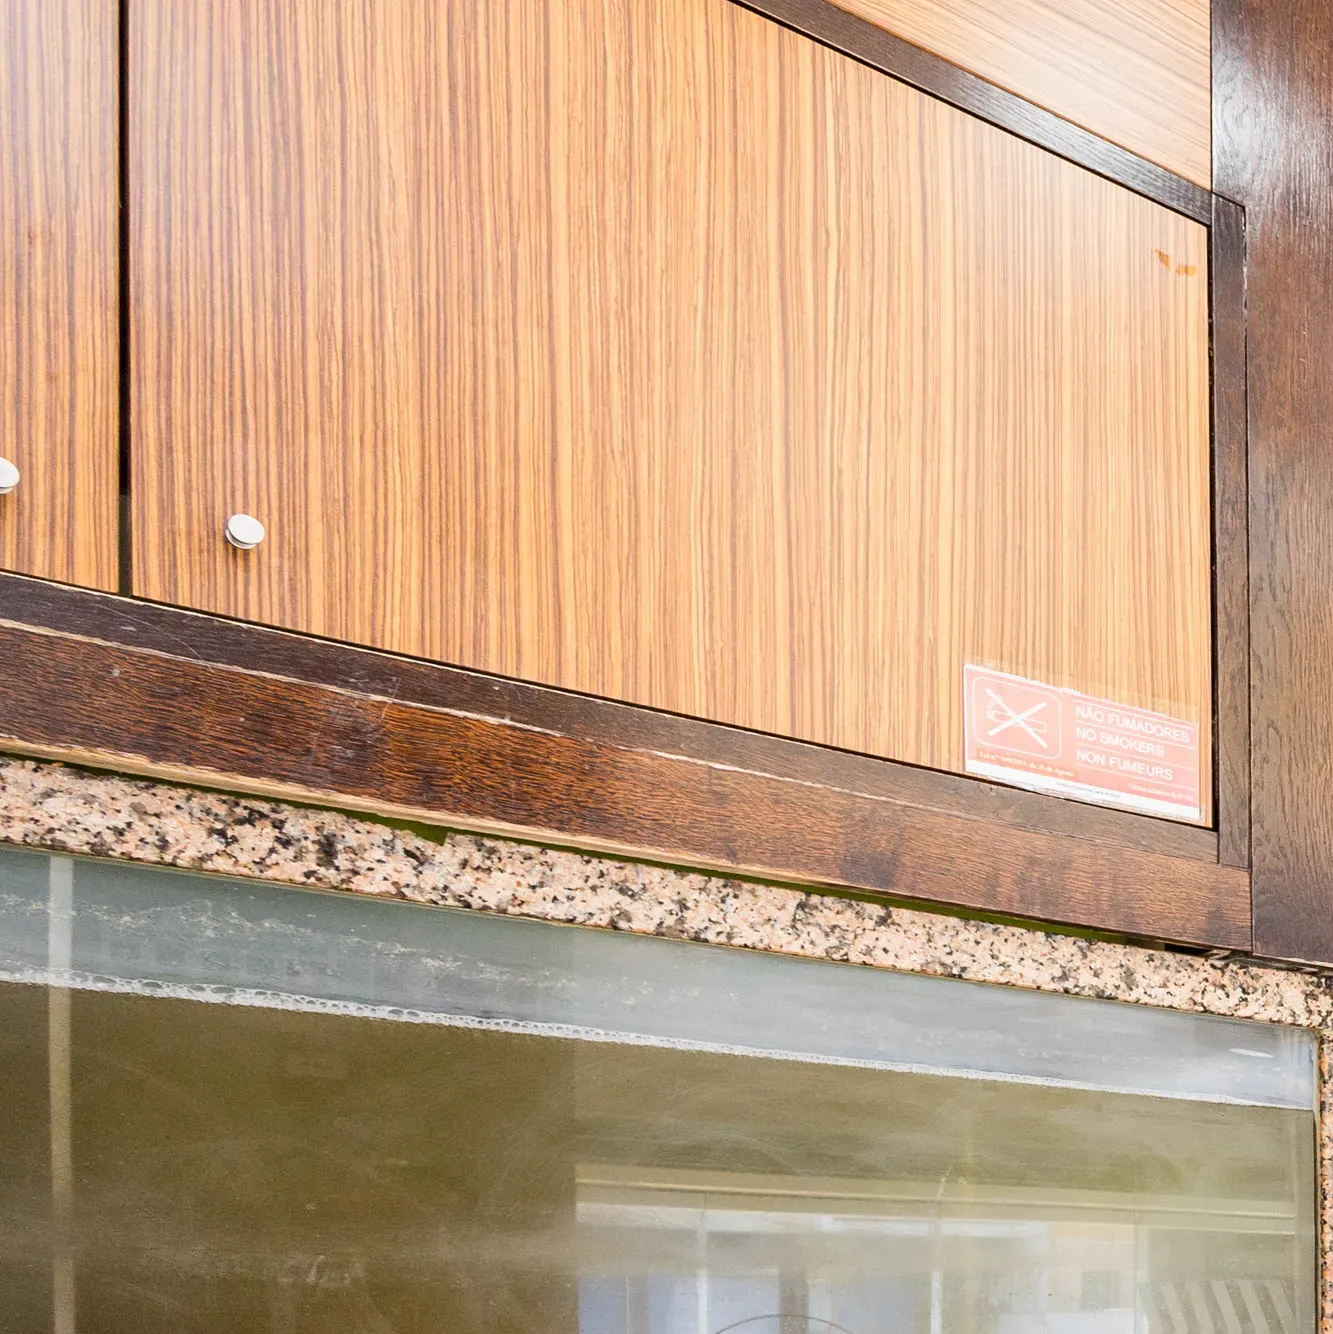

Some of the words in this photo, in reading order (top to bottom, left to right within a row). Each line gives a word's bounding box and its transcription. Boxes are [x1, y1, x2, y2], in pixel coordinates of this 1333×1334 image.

[1075, 705, 1105, 722] NÃO
[1108, 712, 1190, 743] FUMADORES
[1075, 727, 1097, 741] NO
[1100, 731, 1165, 757] SMOKERS
[1075, 748, 1106, 766] NON
[1109, 757, 1173, 781] FUMEURS
